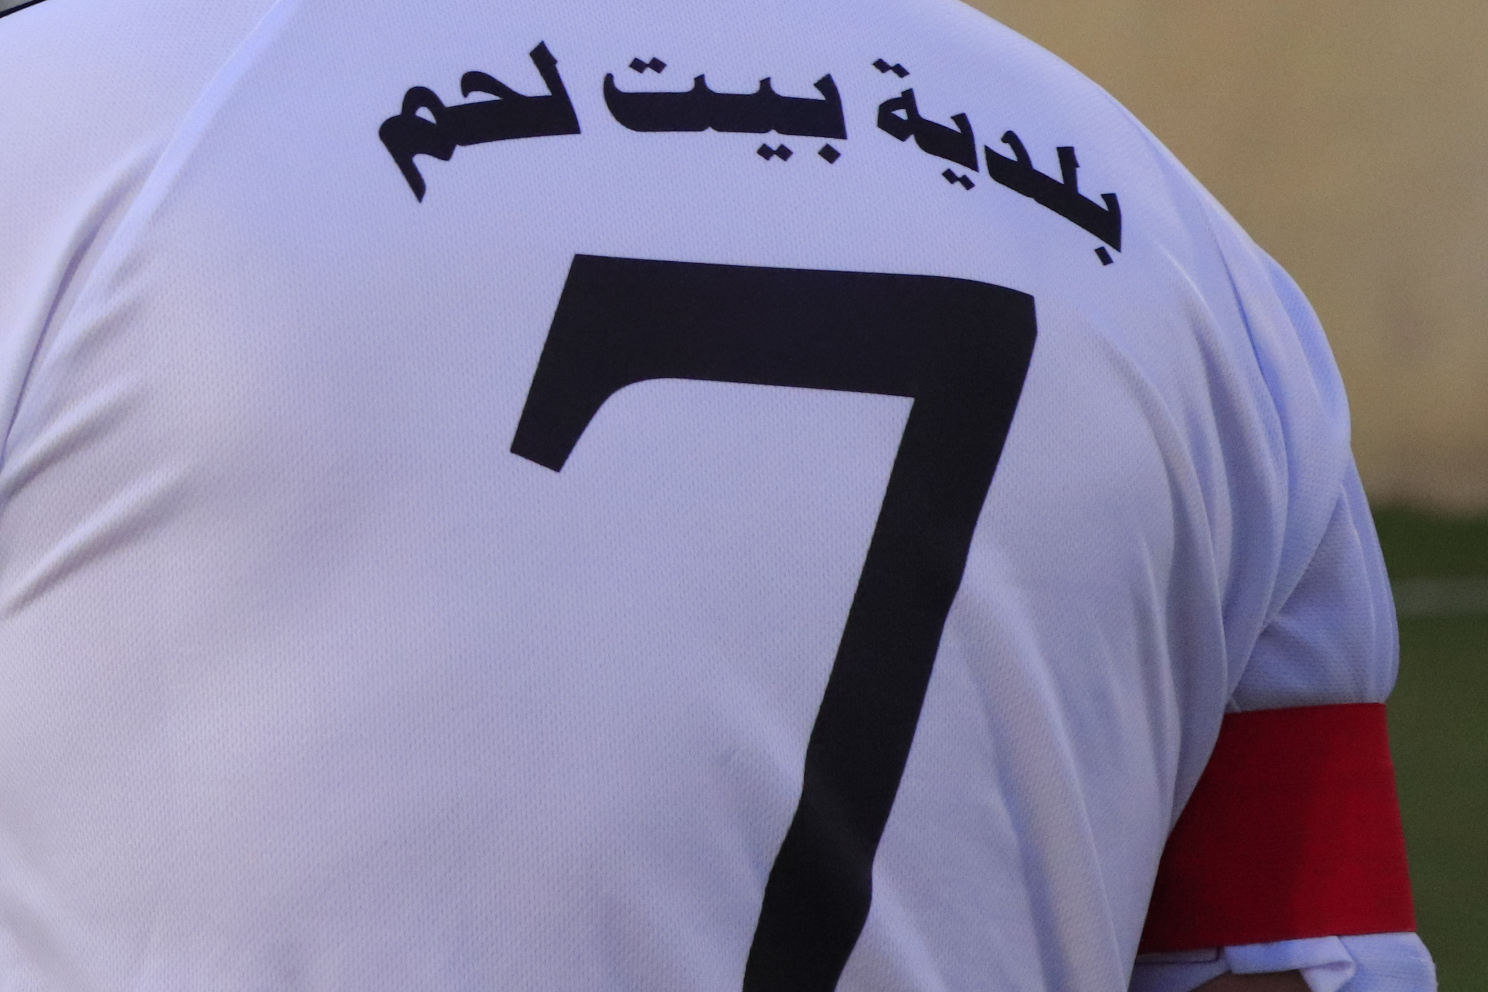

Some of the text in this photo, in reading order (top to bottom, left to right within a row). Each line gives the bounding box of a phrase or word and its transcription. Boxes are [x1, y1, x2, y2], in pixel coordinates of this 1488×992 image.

[377, 40, 1124, 267] بلدية بيت لحم
[510, 253, 1040, 992] 7
